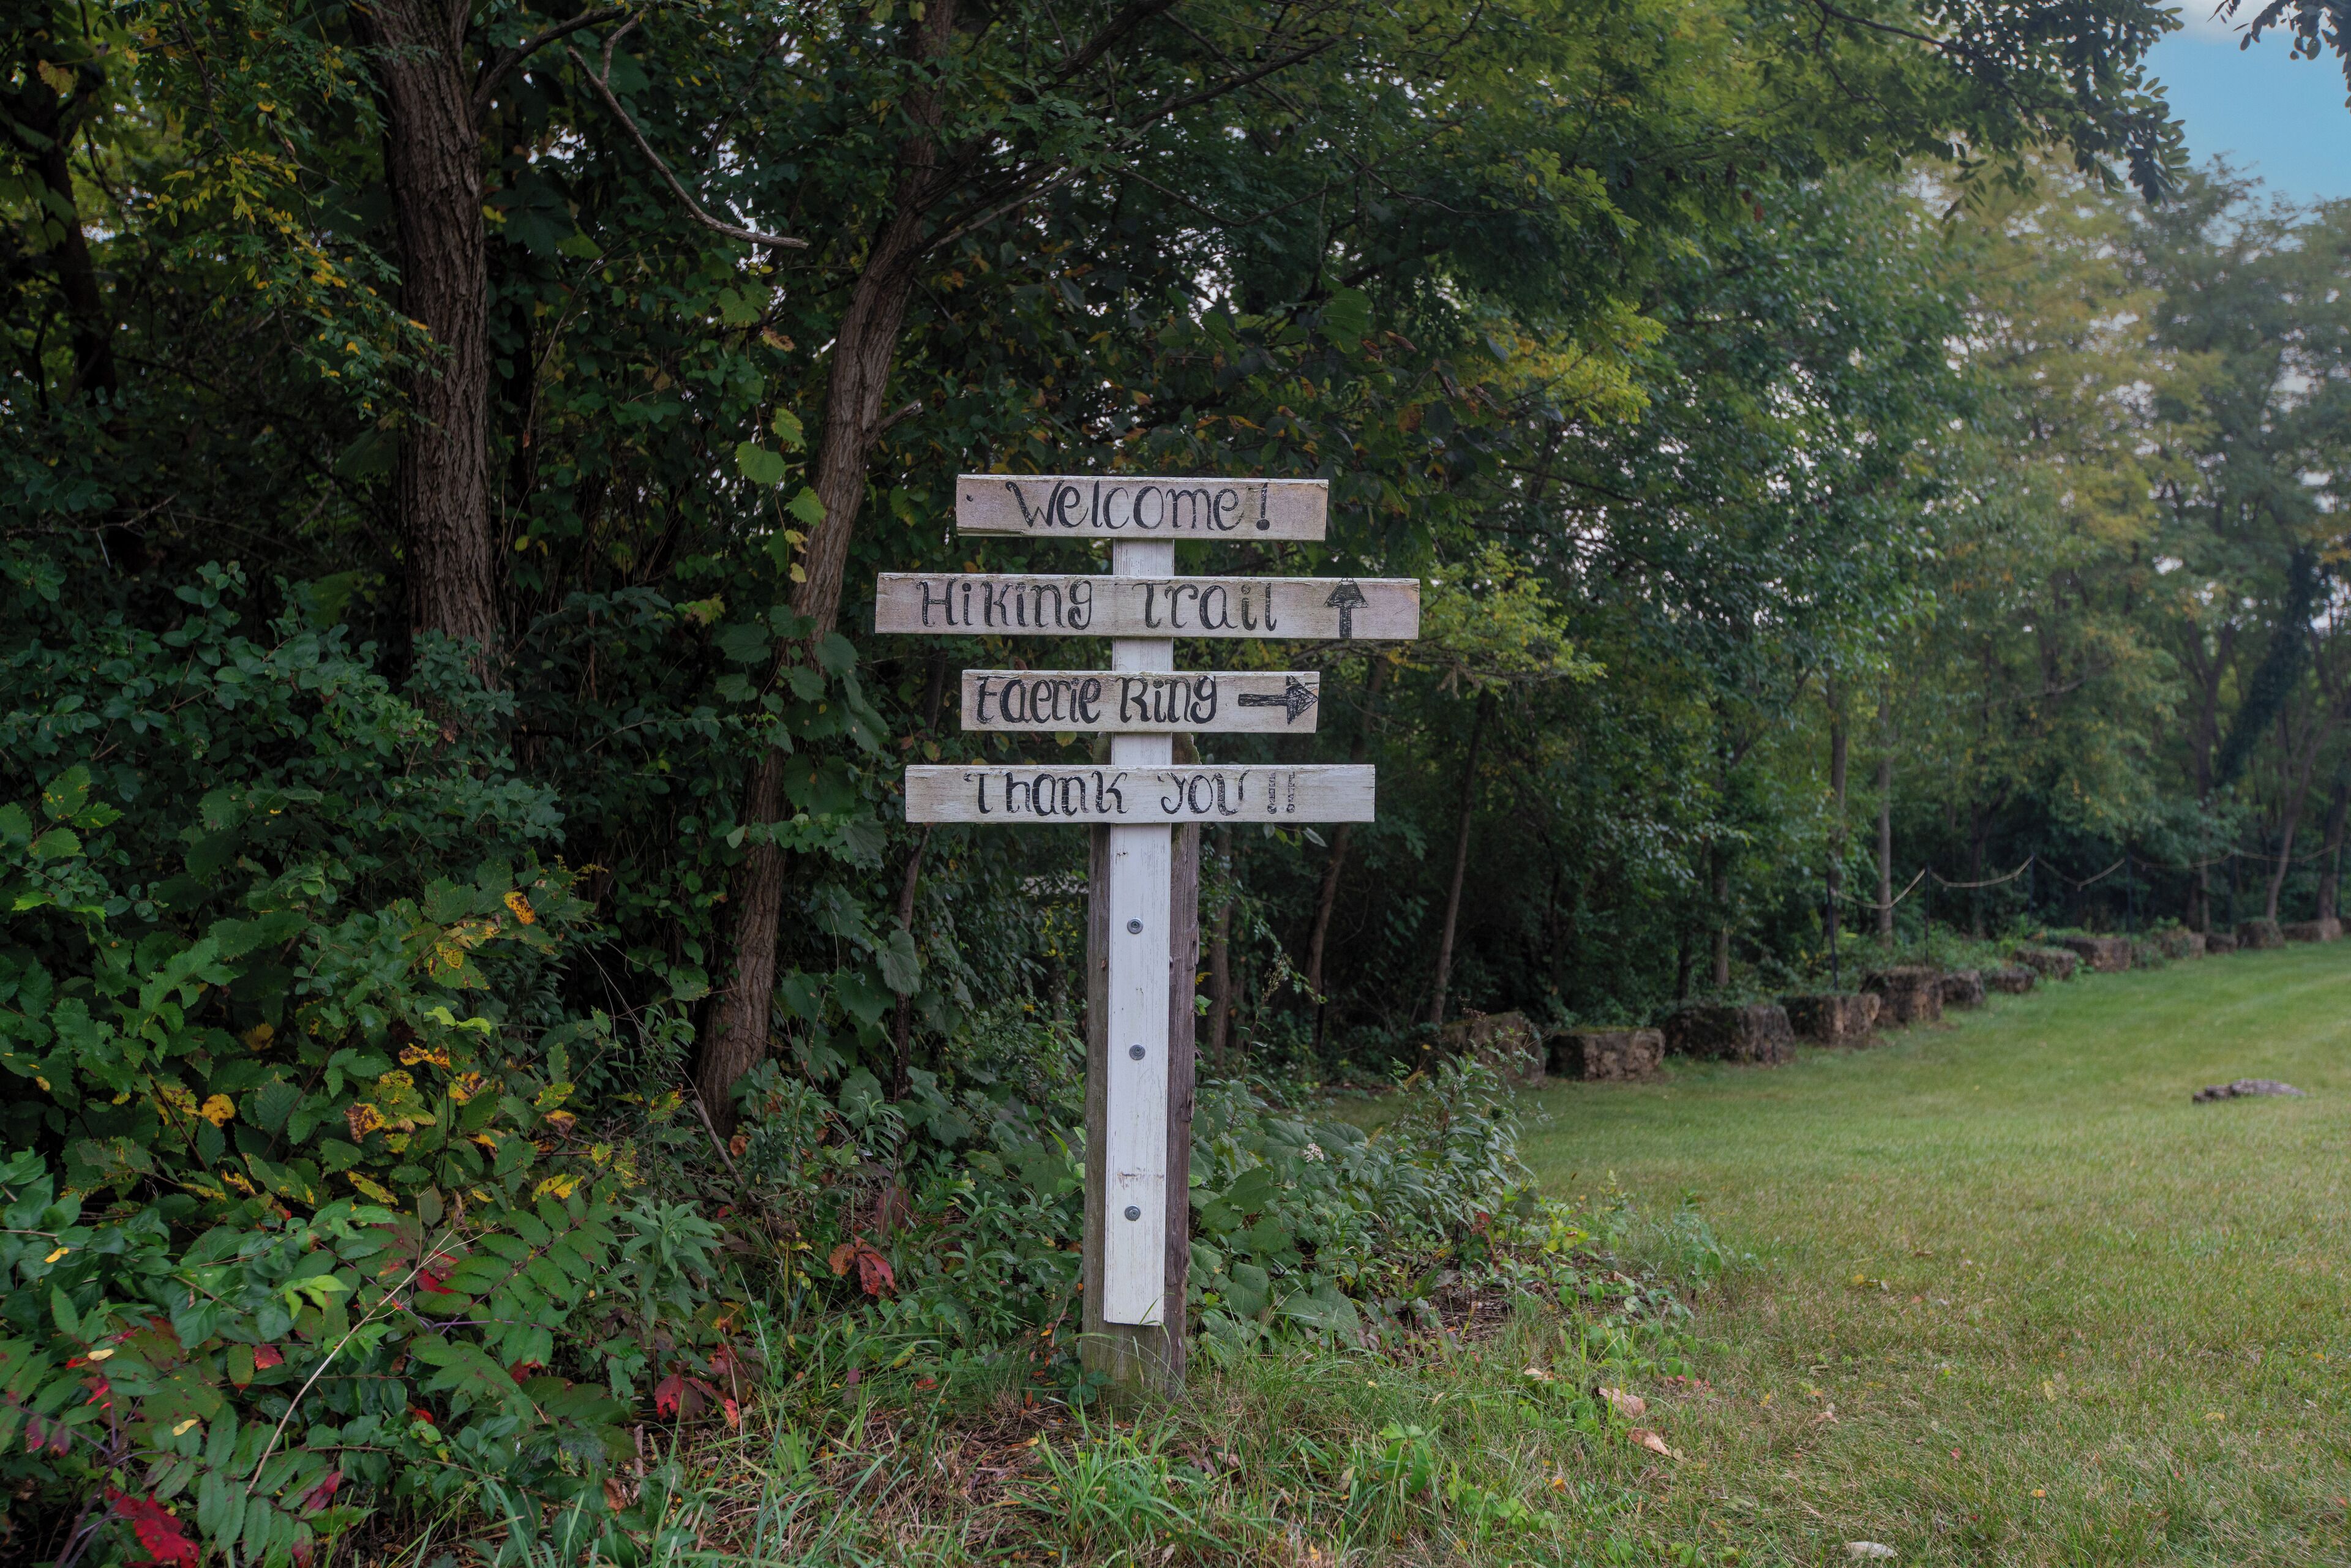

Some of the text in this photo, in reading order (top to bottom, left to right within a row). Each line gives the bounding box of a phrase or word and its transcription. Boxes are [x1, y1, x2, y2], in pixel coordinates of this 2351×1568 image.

[916, 579, 1277, 631] Hiking Trail
[977, 675, 1217, 724] Faerie Ring
[963, 770, 1130, 816] Thank
